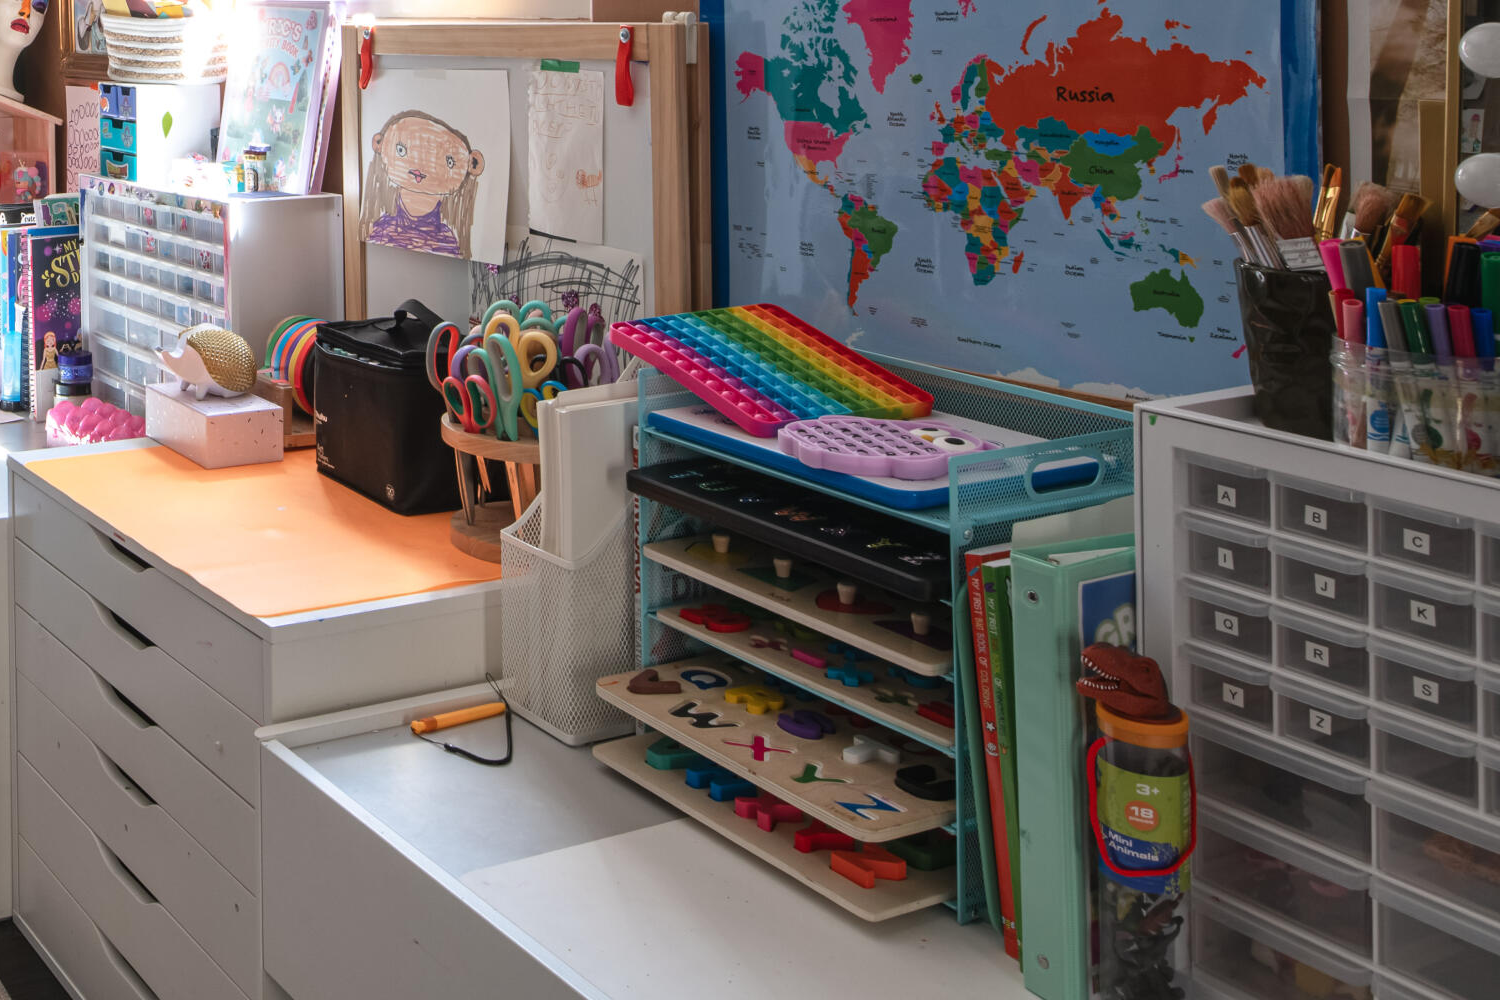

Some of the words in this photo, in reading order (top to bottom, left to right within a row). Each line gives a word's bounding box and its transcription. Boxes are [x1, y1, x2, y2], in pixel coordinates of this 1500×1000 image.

[1056, 86, 1115, 102] Russia
[1088, 166, 1115, 176] China
[63, 239, 77, 252] MY
[51, 248, 80, 288] ST
[1222, 492, 1232, 502] A
[1312, 512, 1322, 523] B
[1412, 536, 1424, 548] C
[1223, 554, 1227, 564] I
[972, 578, 980, 586] MY
[1320, 580, 1328, 592] J
[972, 587, 983, 616] FIRST
[1417, 607, 1428, 620] K
[1223, 618, 1234, 630] Q
[976, 632, 986, 653] BOOK
[1314, 648, 1324, 660] R
[978, 656, 988, 668] OF
[1229, 689, 1238, 700] Y
[1422, 684, 1432, 696] S
[1316, 716, 1325, 728] Z
[1136, 783, 1160, 796] 3+
[1130, 806, 1154, 819] 18
[1109, 830, 1133, 848] Mini
[1108, 840, 1160, 862] Animals
